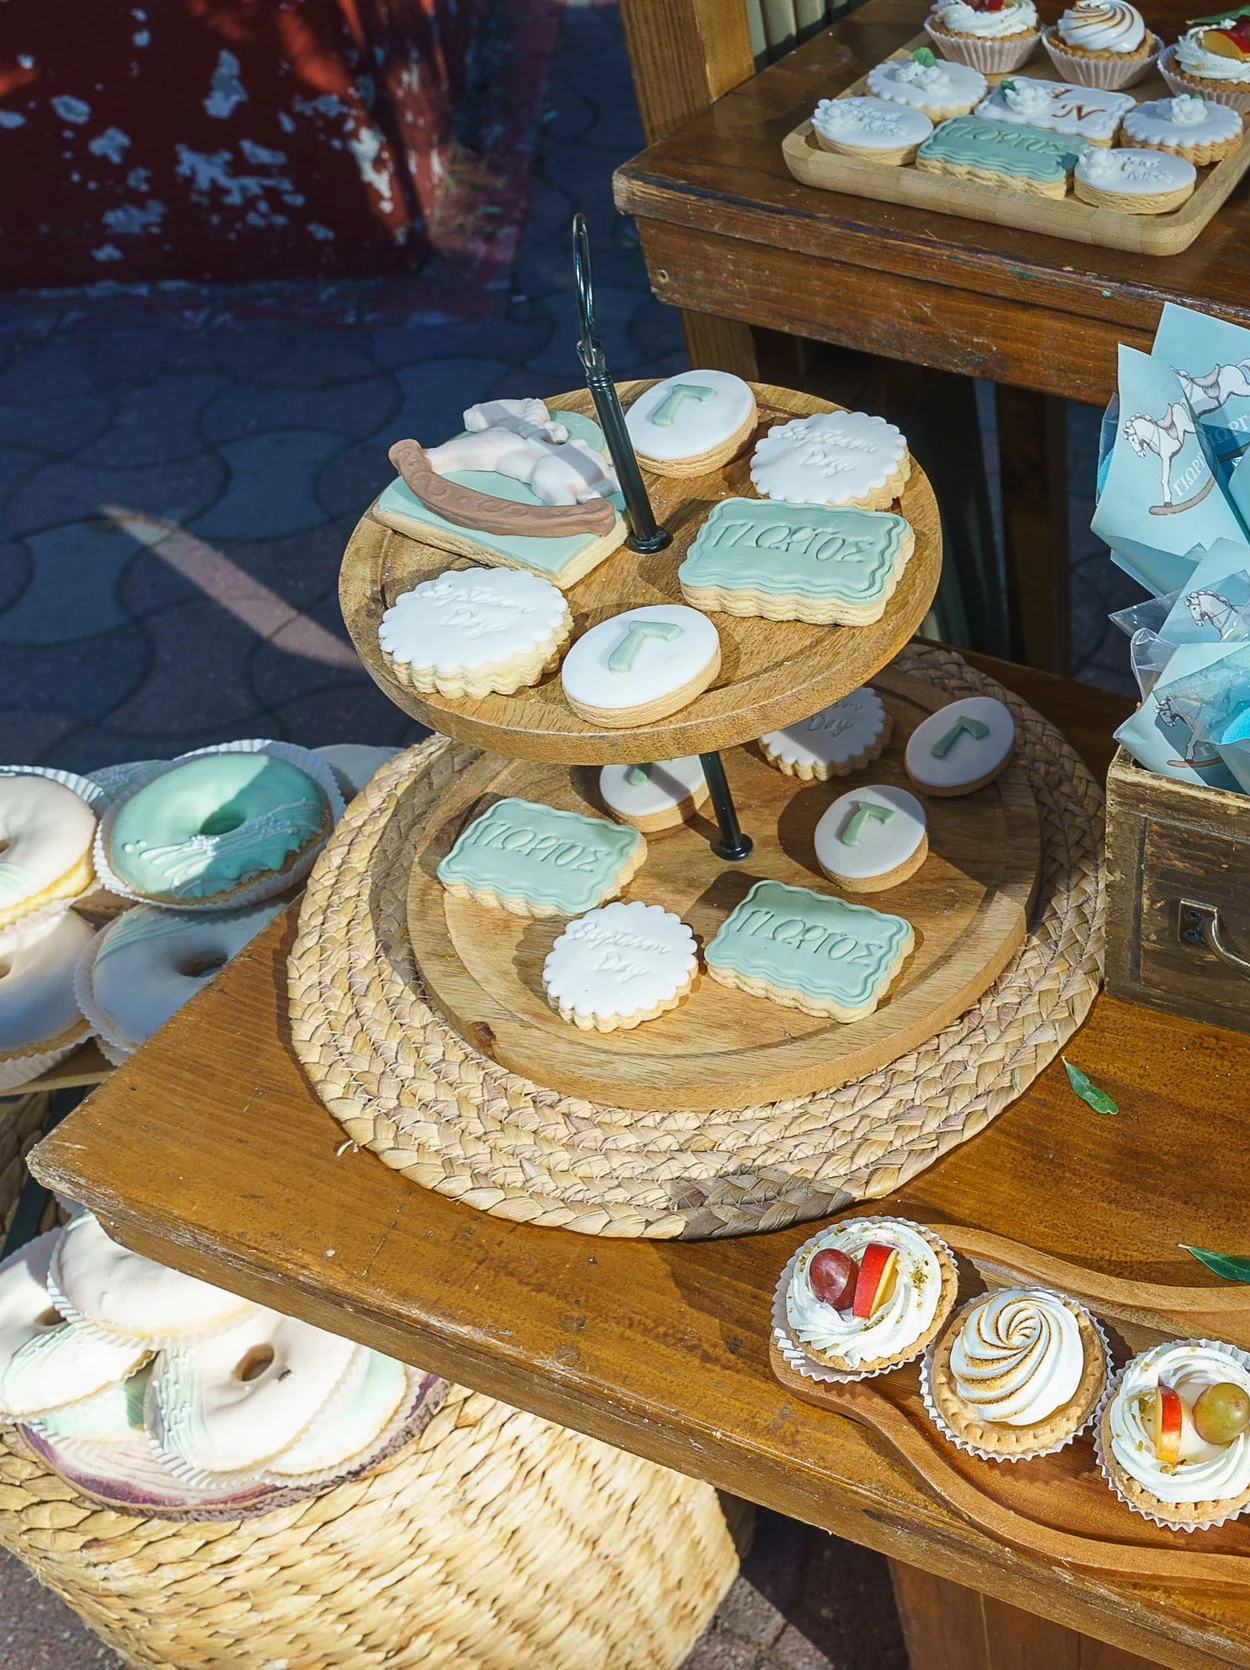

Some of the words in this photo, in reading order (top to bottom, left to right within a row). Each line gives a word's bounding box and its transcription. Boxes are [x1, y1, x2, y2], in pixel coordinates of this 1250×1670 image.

[713, 521, 875, 564] ΓΙΩΡΓΟΣ
[806, 713, 854, 738] Day
[472, 822, 612, 873] ΓΙΩΡΓΟΣ
[736, 909, 884, 967] ΓΙΩΡΓΟΣ
